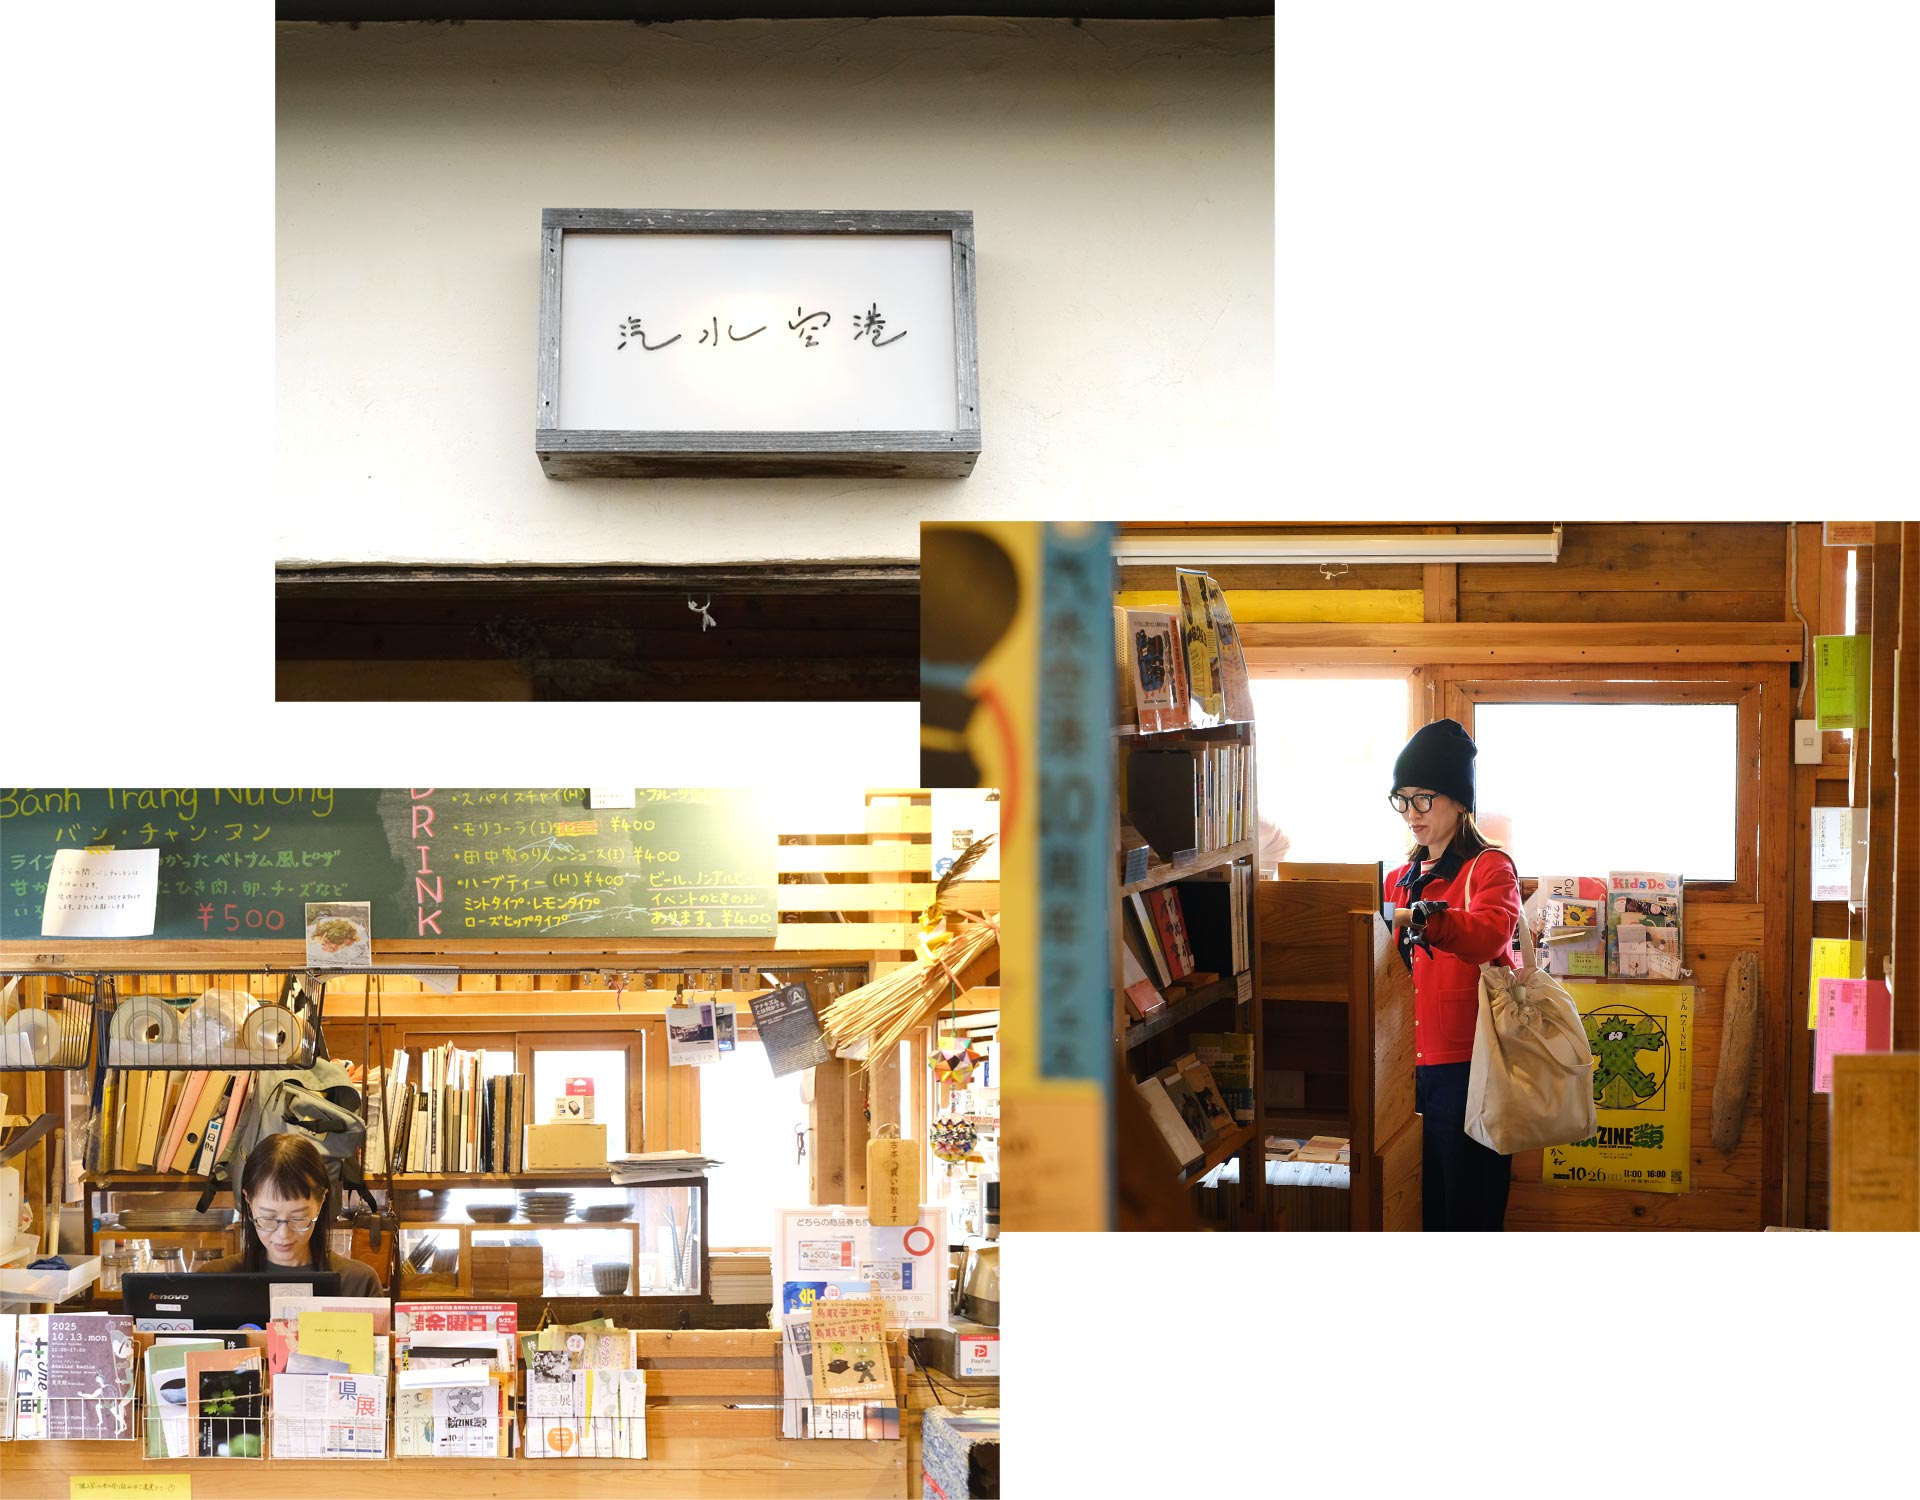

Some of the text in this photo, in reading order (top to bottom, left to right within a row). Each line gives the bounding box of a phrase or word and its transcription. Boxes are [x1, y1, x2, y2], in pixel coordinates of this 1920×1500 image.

[617, 303, 907, 350] 汽水空港
[634, 846, 680, 864] ¥400
[197, 903, 285, 932] ¥500
[1570, 1123, 1664, 1149] ZINE類
[149, 1292, 189, 1300] lenovo
[52, 1322, 77, 1331] 2025
